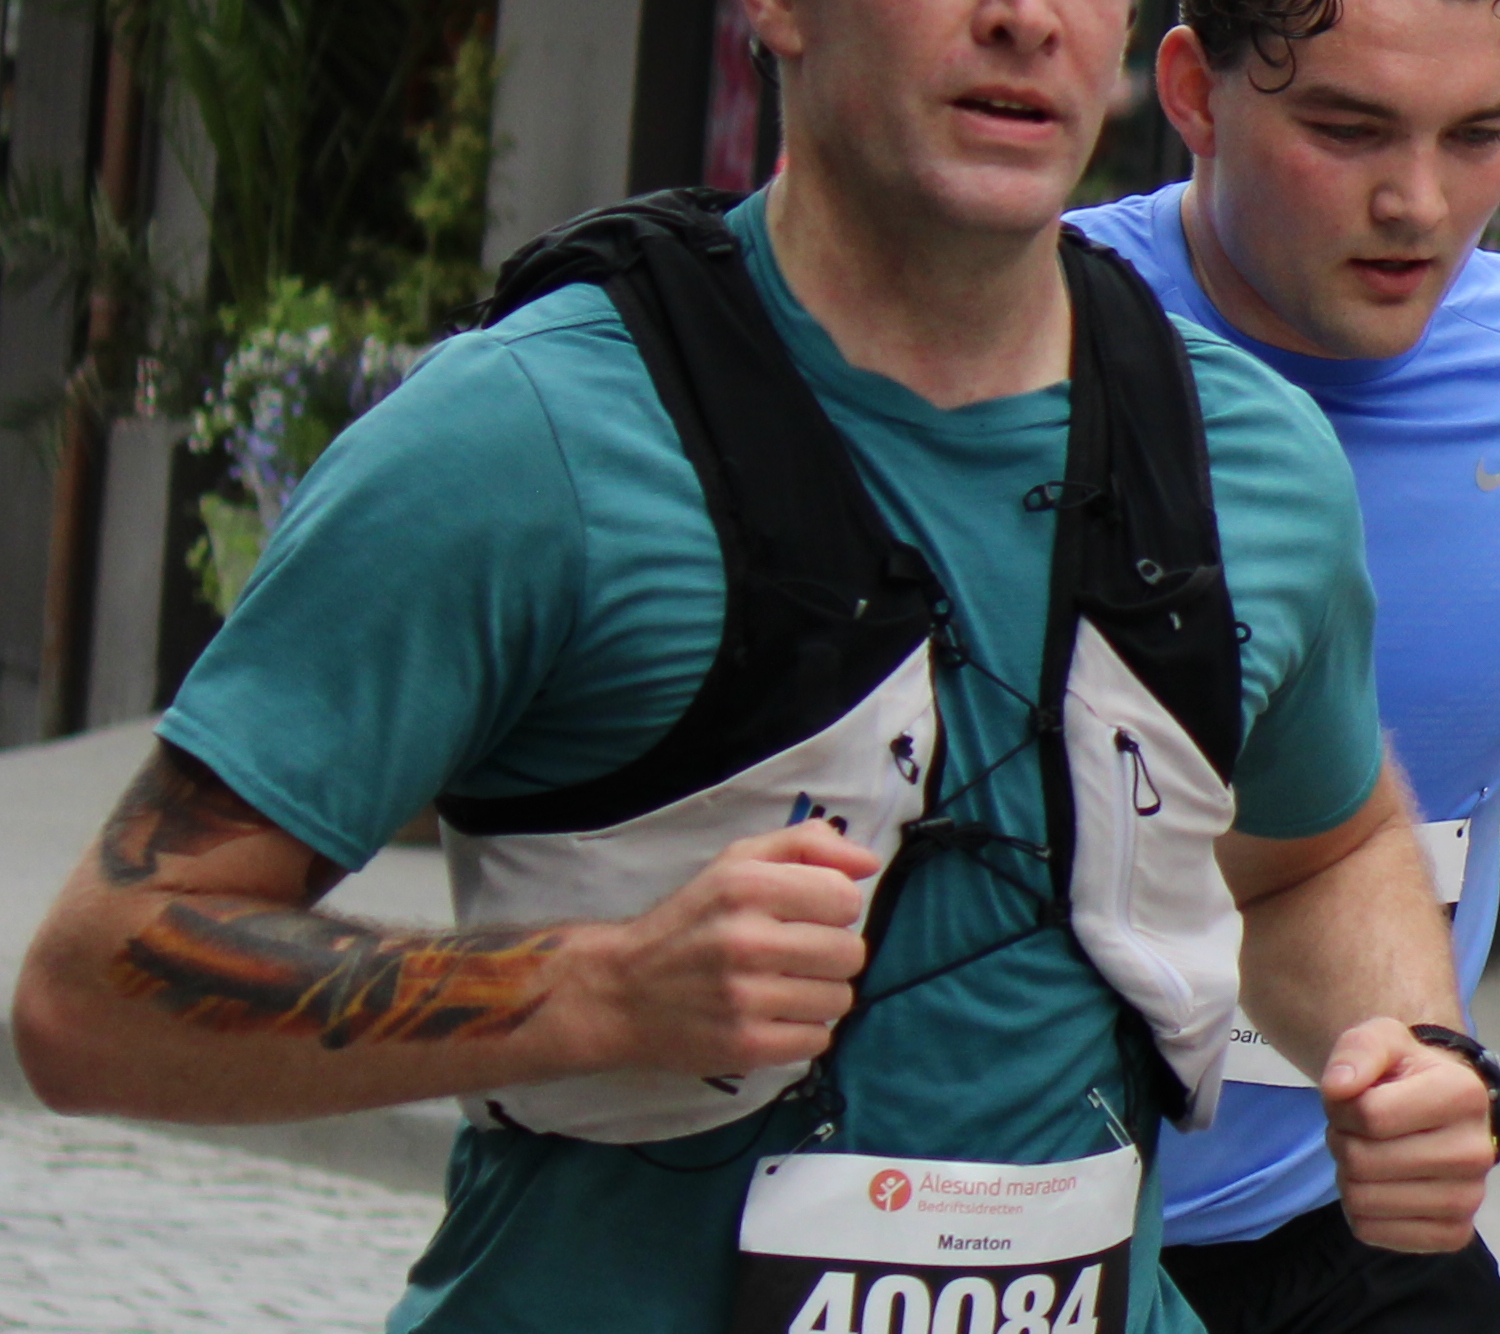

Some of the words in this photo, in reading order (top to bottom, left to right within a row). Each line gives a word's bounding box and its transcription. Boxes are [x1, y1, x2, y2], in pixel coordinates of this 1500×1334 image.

[919, 1173, 1002, 1197] Ålesund
[1006, 1174, 1077, 1196] maraton
[917, 1200, 1023, 1215] Bedriftsidretten
[937, 1234, 1012, 1251] Maraton
